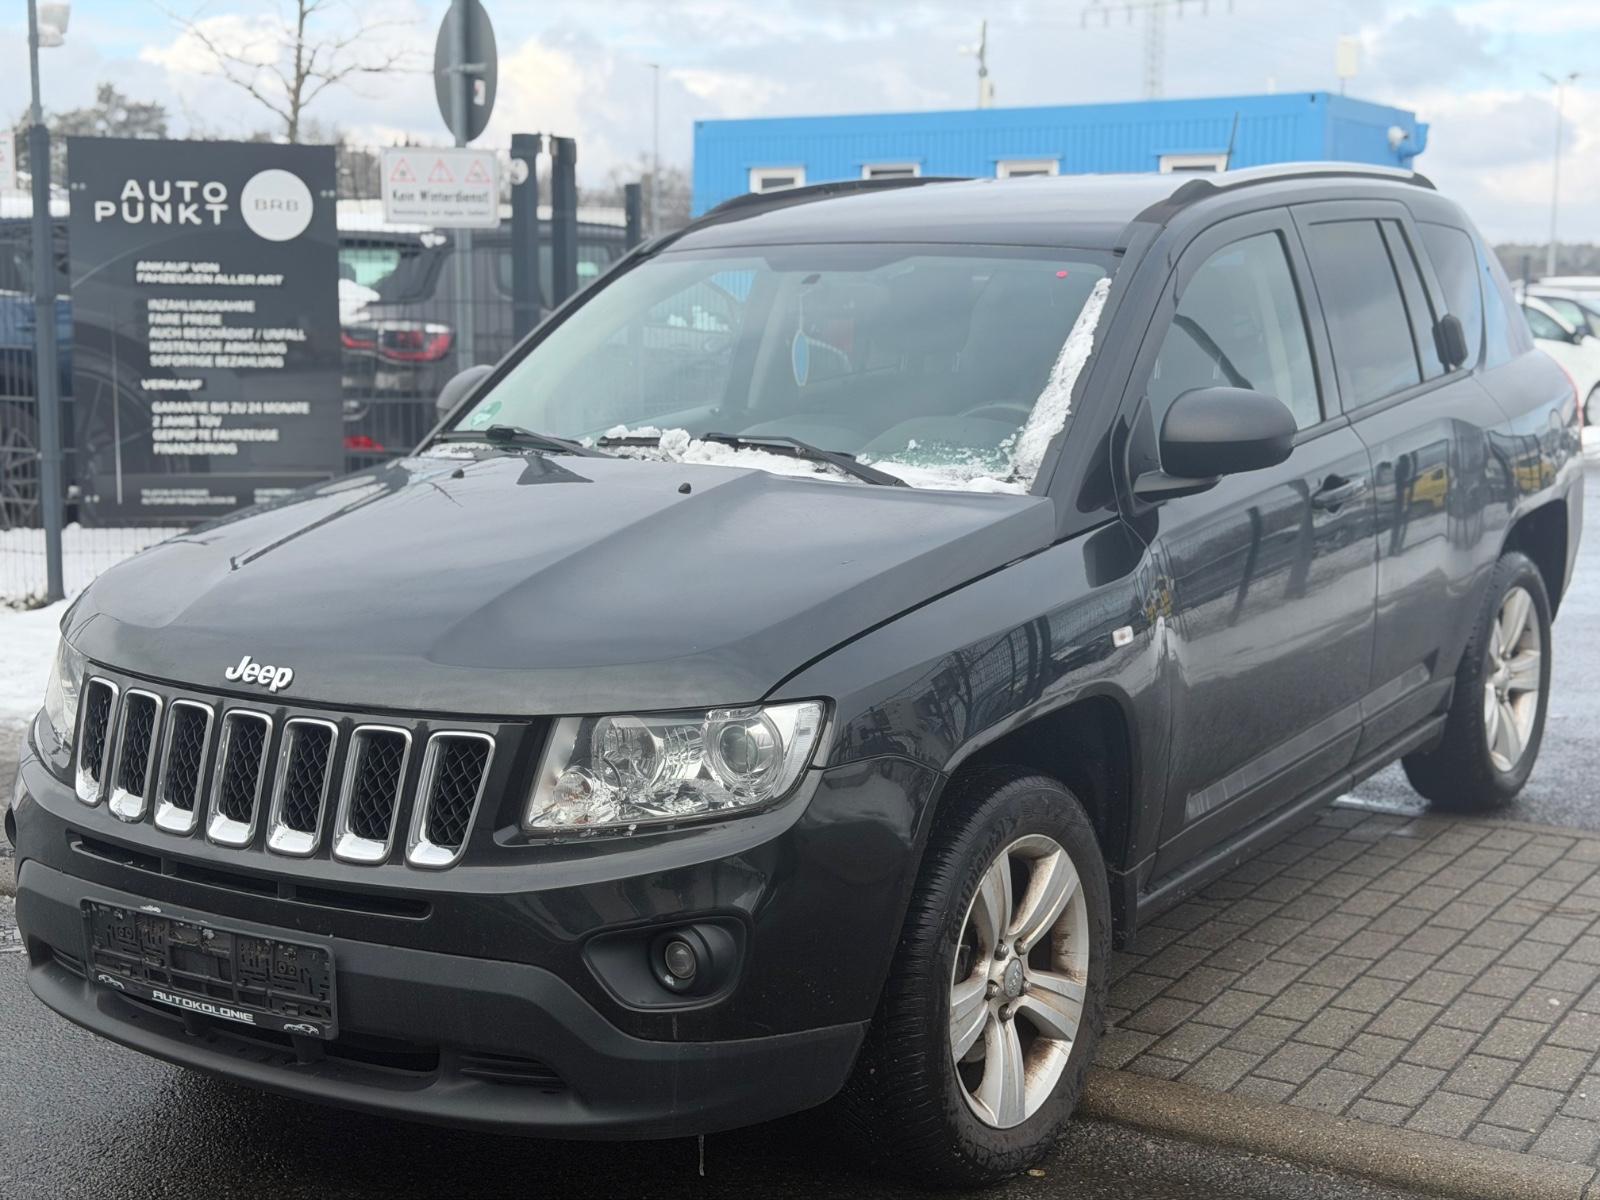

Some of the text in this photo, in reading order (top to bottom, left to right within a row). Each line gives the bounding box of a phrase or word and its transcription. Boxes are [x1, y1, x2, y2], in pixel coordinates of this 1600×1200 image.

[120, 179, 228, 203] AUTO
[392, 189, 415, 200] Kein
[253, 198, 300, 212] BRB
[94, 200, 229, 225] PUNKT
[136, 261, 220, 273] ANKAUF VON
[136, 272, 284, 285] FAHRZEUGEN ALLER ART
[148, 312, 223, 326] FAIRE PREISE
[149, 327, 182, 340] AUCH
[262, 328, 307, 341] UNFALL
[149, 341, 288, 354] KOSTENLOSE ABHOLUNG
[150, 355, 285, 368] SOFORTIGE BEZAHLUNG
[141, 379, 203, 390] VERKAUF
[152, 402, 209, 414] GARANTIE
[210, 402, 230, 414] BIS
[230, 402, 247, 414] ZU
[263, 402, 311, 414] MONATE
[152, 415, 161, 427] 2
[161, 415, 197, 427] JAHRE
[212, 429, 279, 441] FAHRZEUGE
[153, 442, 239, 454] FINANZIERUNG
[224, 655, 294, 693] Jeep
[152, 989, 254, 1022] AUTOKOLONIE
